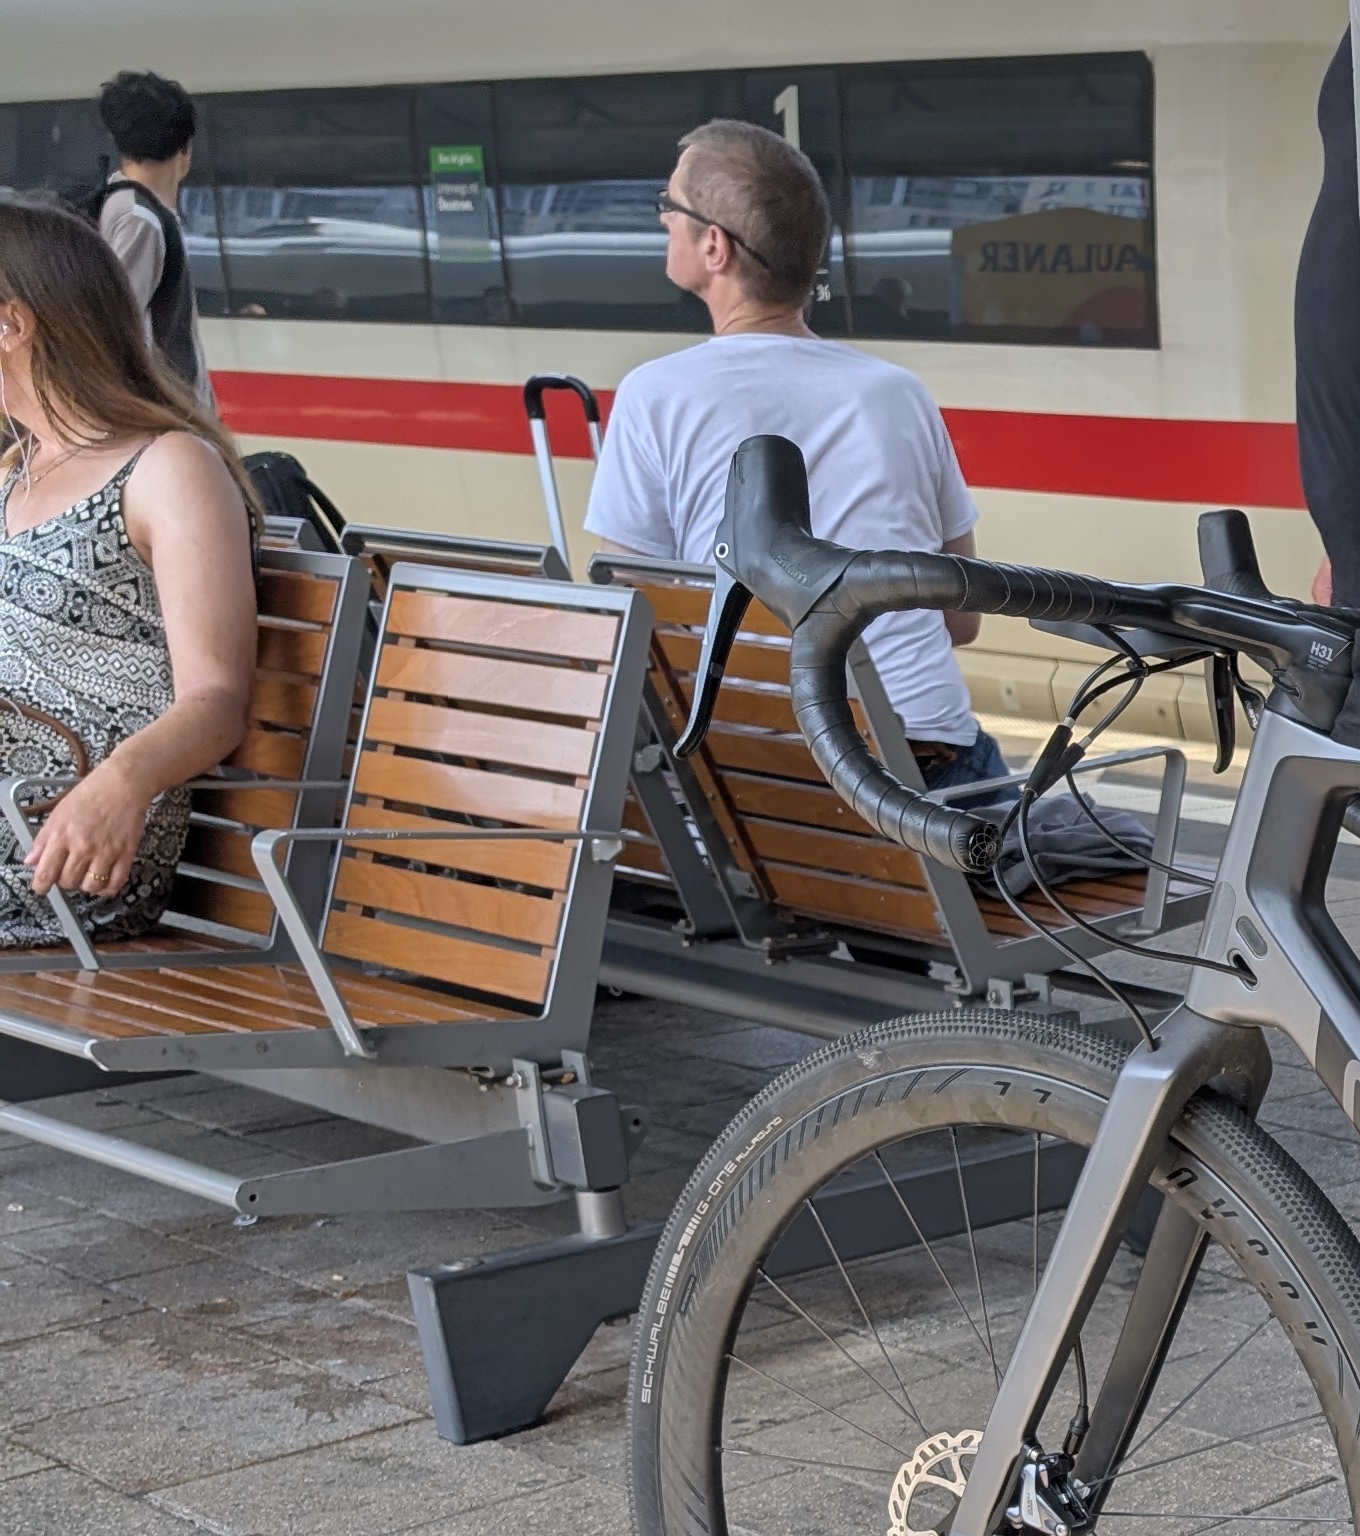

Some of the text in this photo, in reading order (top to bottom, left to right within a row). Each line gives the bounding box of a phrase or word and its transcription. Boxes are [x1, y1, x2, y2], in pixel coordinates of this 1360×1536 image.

[773, 85, 800, 150] 1
[1310, 640, 1334, 662] H31
[641, 1115, 783, 1404] SCHWALBE G-ONE ALLROUND
